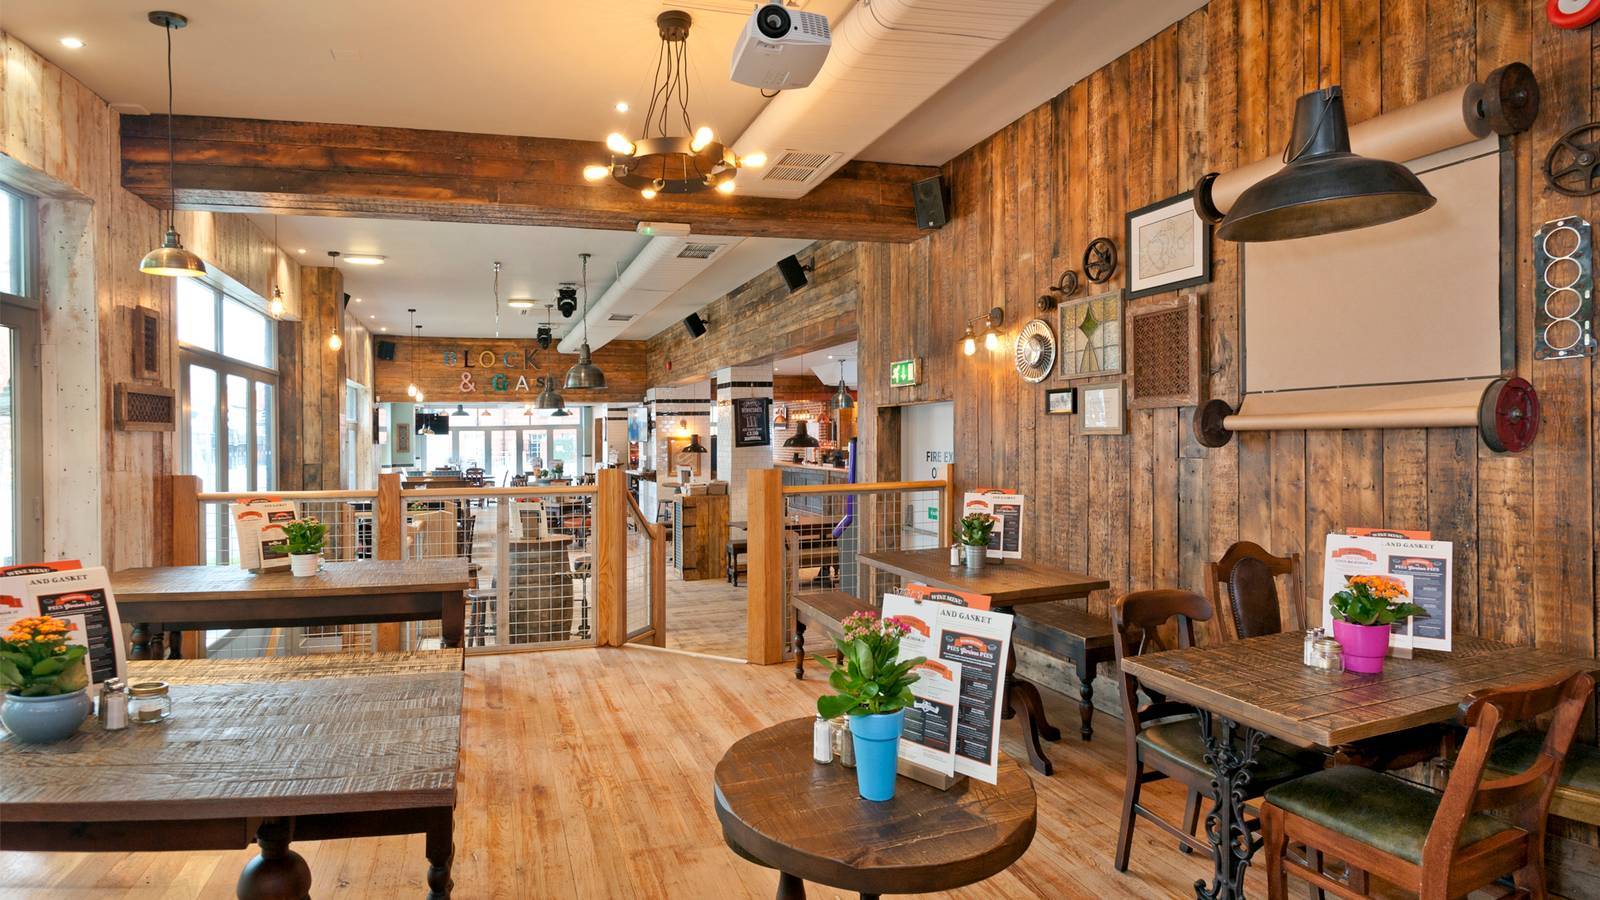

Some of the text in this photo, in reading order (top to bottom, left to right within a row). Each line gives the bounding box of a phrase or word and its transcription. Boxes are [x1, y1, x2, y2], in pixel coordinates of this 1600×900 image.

[459, 371, 477, 393] &
[926, 451, 942, 463] FIRE
[29, 574, 88, 585] AND GASKET
[940, 608, 992, 624] AND GASKET
